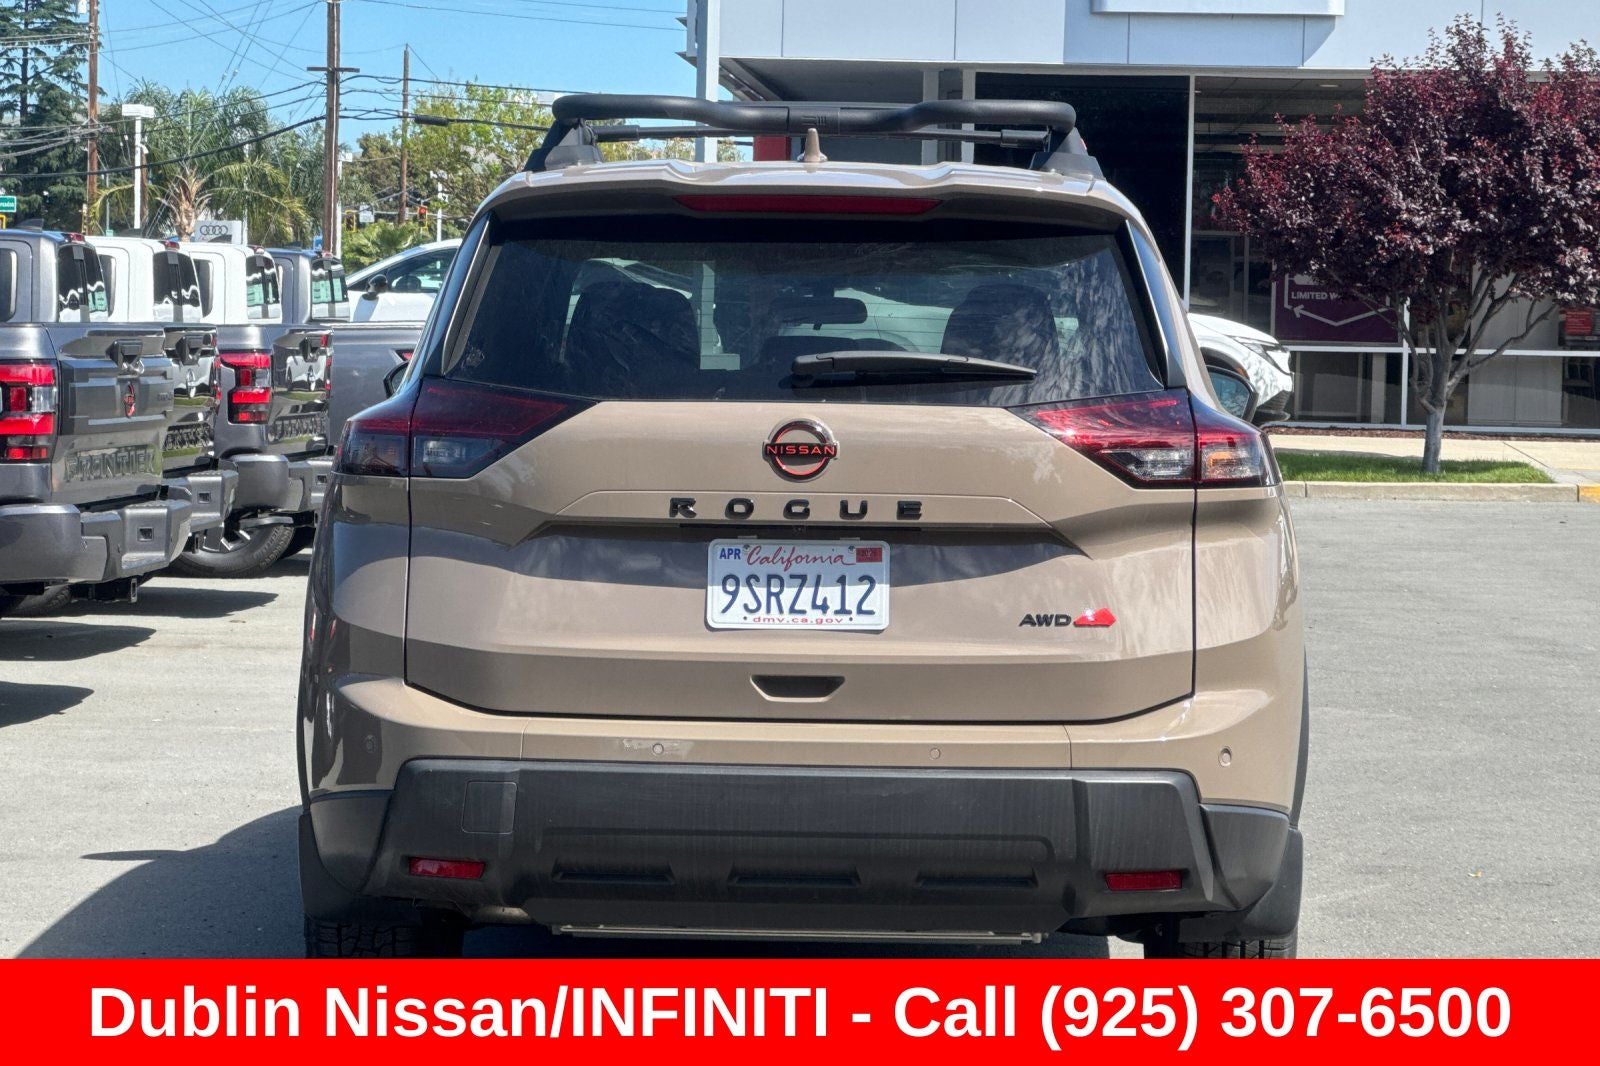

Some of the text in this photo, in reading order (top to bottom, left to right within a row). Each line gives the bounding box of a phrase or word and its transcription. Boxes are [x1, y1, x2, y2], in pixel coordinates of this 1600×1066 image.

[1291, 291, 1328, 300] LIMITED
[766, 444, 836, 456] NISSAN
[669, 497, 923, 520] ROGUE
[719, 547, 741, 560] APR
[747, 545, 856, 571] California
[720, 574, 877, 616] 9SRZ412
[753, 616, 843, 625] dmv.ca.gov
[1019, 613, 1072, 627] AWD
